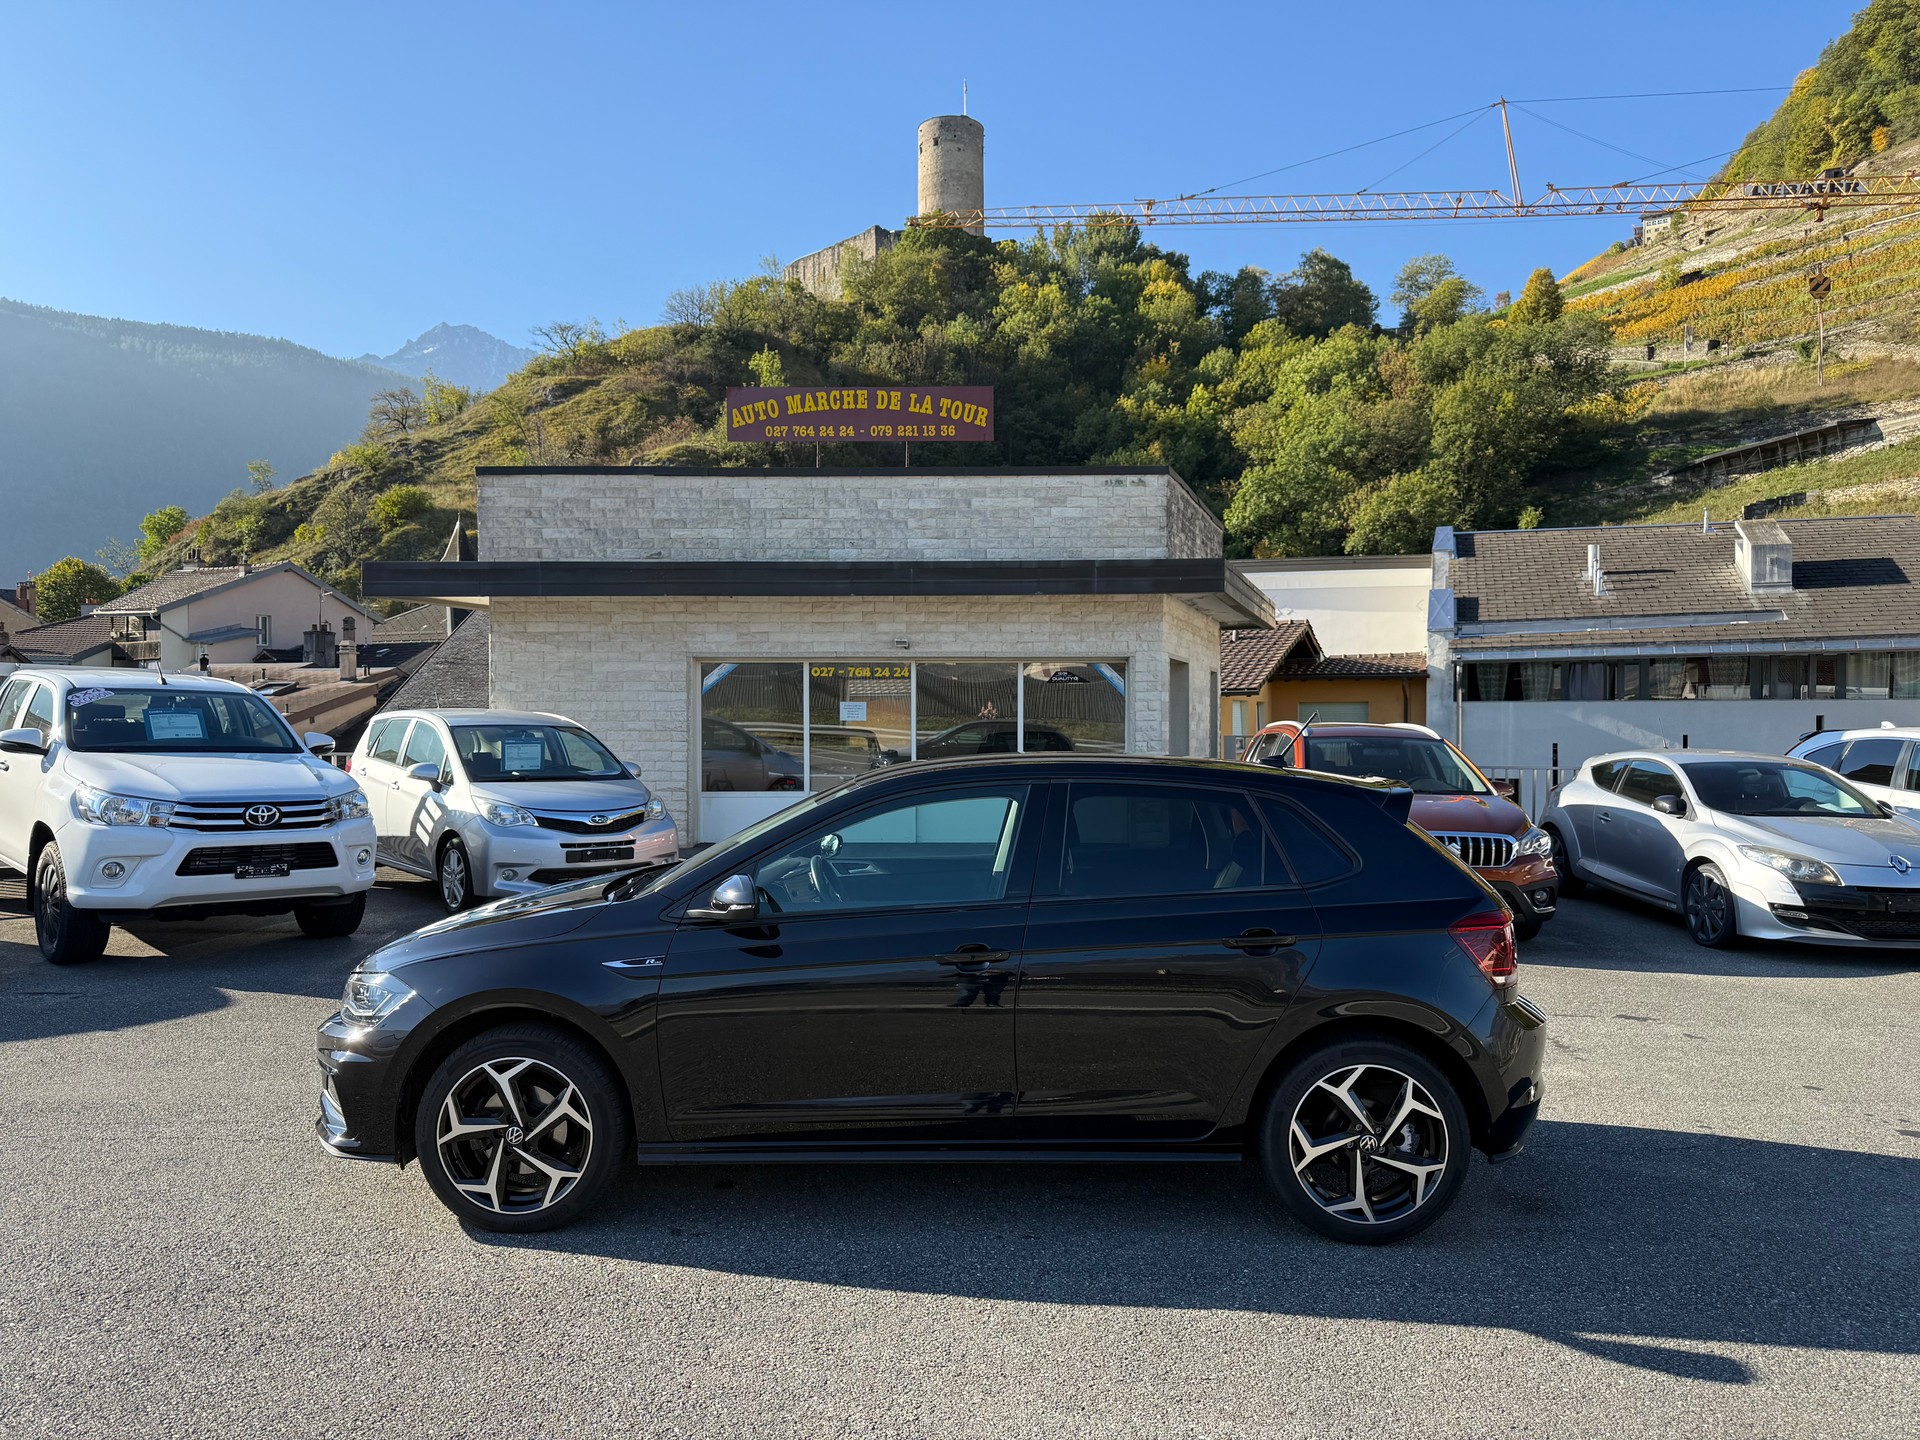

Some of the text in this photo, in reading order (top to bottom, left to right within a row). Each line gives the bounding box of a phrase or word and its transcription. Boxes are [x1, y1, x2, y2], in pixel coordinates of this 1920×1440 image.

[1751, 182, 1860, 196] LIEBHERR
[731, 389, 989, 428] AUTO MARCHE DE LA TOUR
[765, 425, 788, 437] 027
[792, 425, 815, 437] 764
[819, 425, 835, 437] 24
[839, 425, 855, 437] 24
[870, 425, 892, 437] 079
[897, 425, 919, 437] 221
[922, 425, 935, 437] 13
[940, 425, 956, 437] 36
[811, 667, 835, 677] 027
[848, 667, 871, 677] 764
[874, 667, 890, 677] 24
[893, 667, 909, 677] 24
